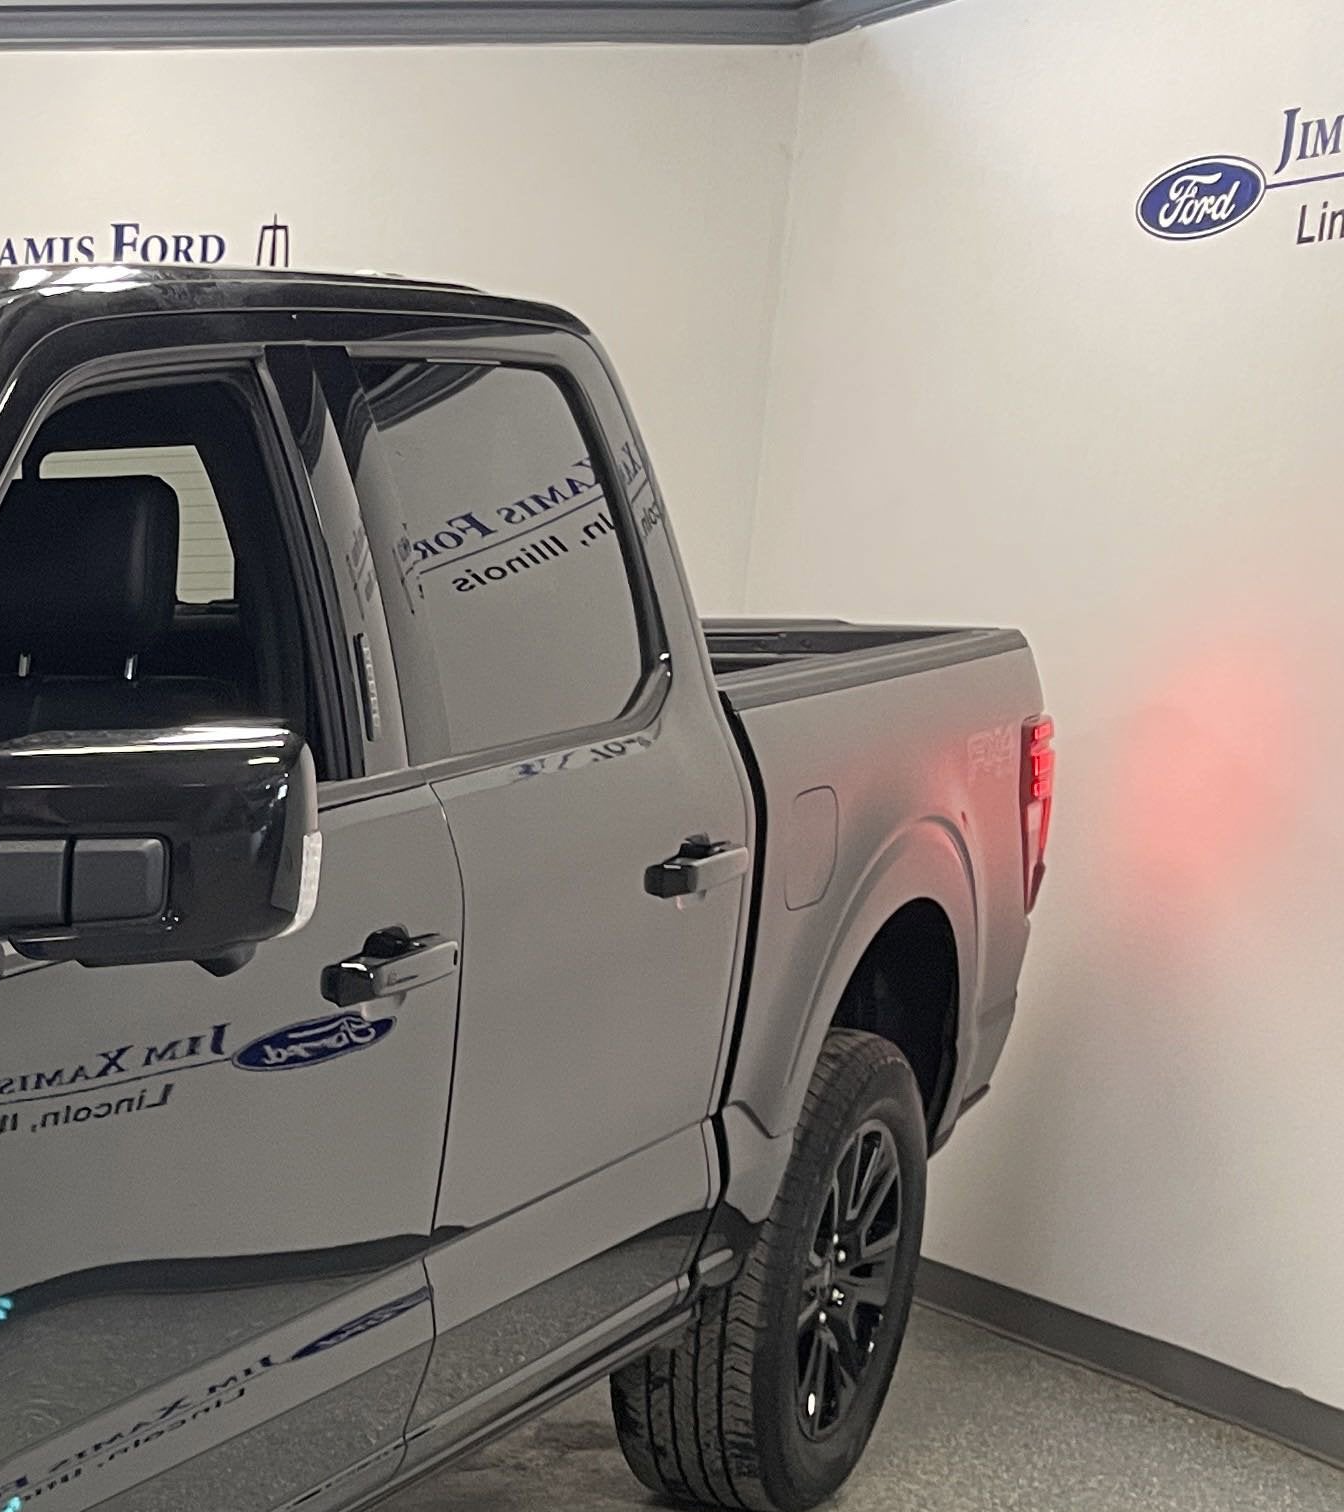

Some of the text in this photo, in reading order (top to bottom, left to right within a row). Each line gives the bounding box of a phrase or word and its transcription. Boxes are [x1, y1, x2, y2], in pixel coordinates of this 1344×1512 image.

[1274, 107, 1344, 175] JIM
[1159, 172, 1240, 228] Ford
[110, 223, 226, 265] FORD
